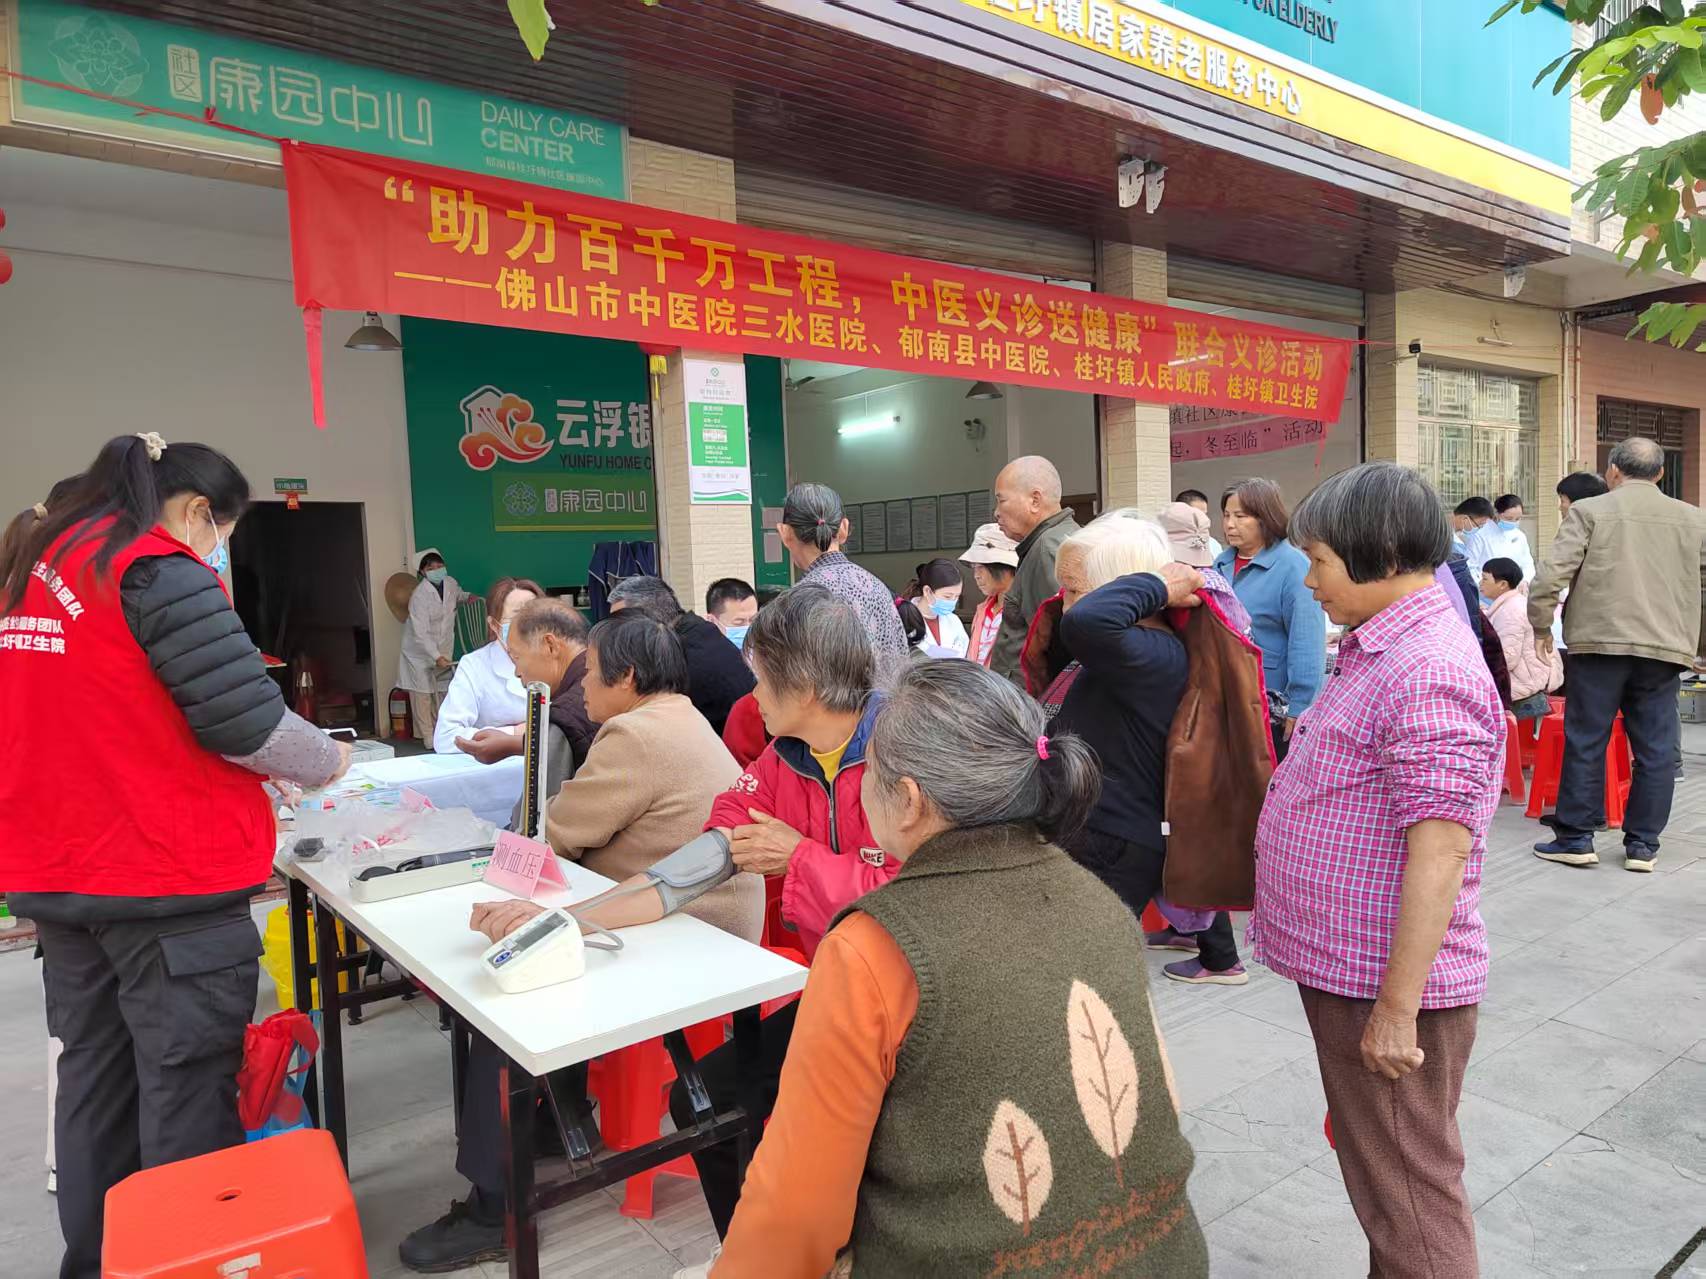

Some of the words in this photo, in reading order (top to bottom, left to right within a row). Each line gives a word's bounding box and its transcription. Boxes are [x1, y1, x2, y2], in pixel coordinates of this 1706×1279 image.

[210, 56, 433, 147] 康园中心
[481, 100, 543, 132] DAILY
[549, 116, 606, 146] CARE
[481, 127, 575, 164] CENTER
[560, 454, 602, 469] YUNFU
[606, 456, 641, 470] HOME
